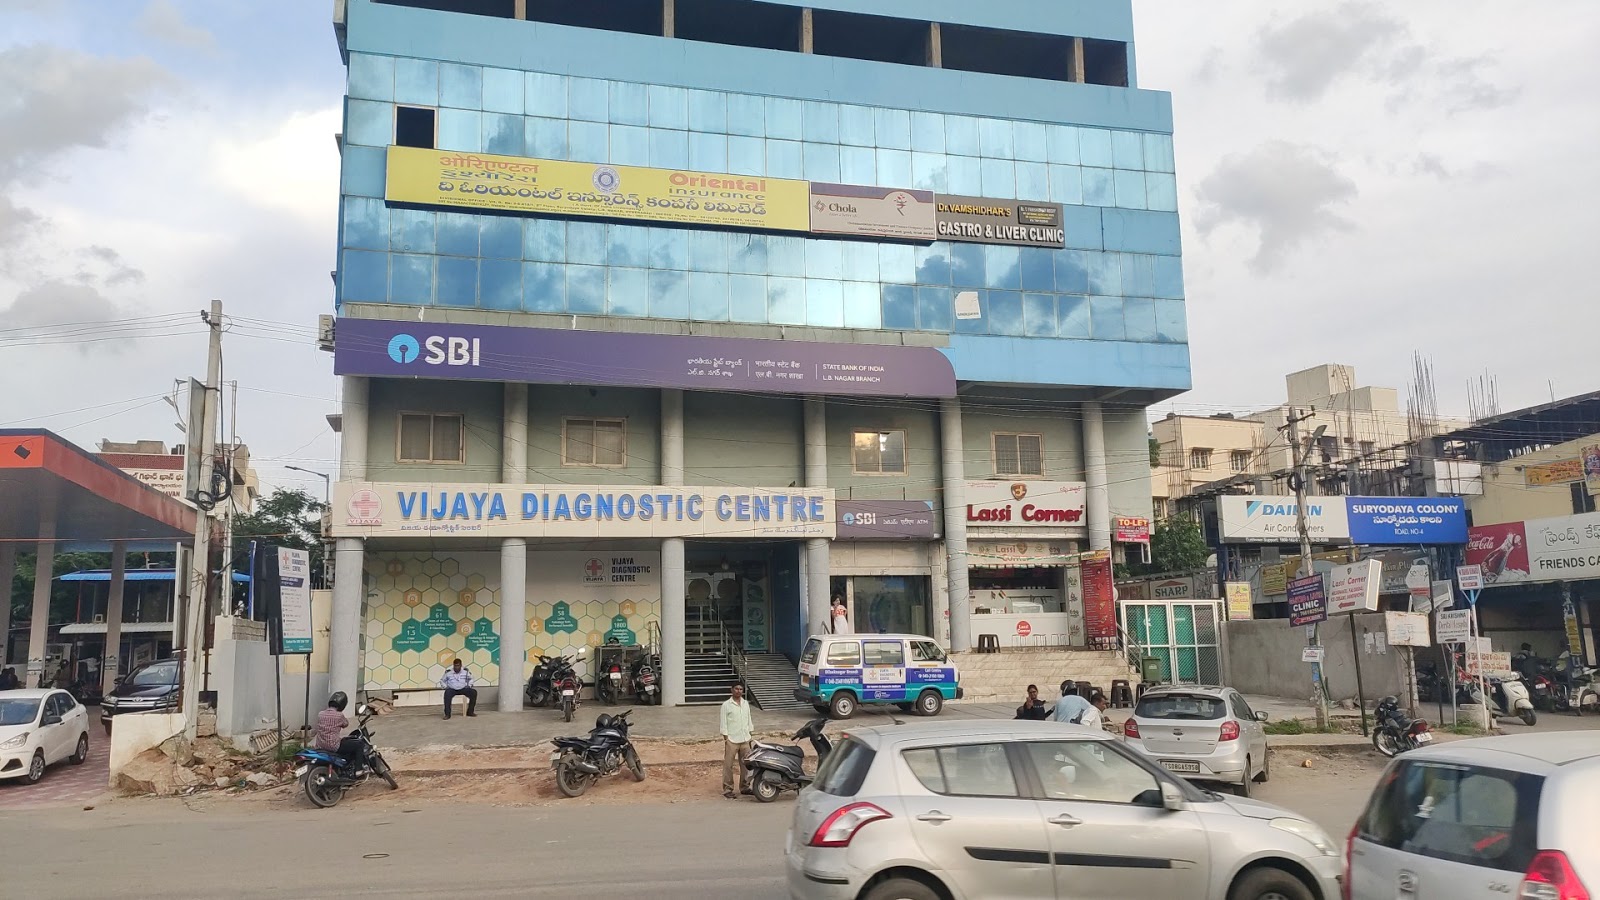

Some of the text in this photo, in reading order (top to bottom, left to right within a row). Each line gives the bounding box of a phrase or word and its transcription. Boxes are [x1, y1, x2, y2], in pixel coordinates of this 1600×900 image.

[669, 173, 766, 192] Oriental
[669, 186, 766, 200] insurance
[828, 203, 857, 213] Chola
[938, 221, 982, 237] GASTRO
[984, 224, 993, 237] &
[995, 225, 1028, 240] LIVER
[1029, 227, 1064, 243] CLINIC
[425, 335, 480, 366] SBI
[398, 491, 825, 521] VIJAYA DIAGNOSTIC CENTRE
[1263, 504, 1322, 516] DAIIN
[1353, 505, 1459, 513] SURYODAYA COLONY
[967, 503, 1083, 522] Lassi Corner
[856, 513, 876, 525] SBI
[1264, 523, 1325, 533] Air Condners
[995, 545, 1016, 553] Lassi
[612, 566, 651, 574] DIAGNOSTIC
[1399, 561, 1413, 570] Plu
[1540, 558, 1585, 570] FRIENDS
[612, 574, 636, 582] CENTRE
[1347, 576, 1366, 584] Corner
[1155, 585, 1188, 597] SHARP
[1293, 600, 1319, 612] CLINIC
